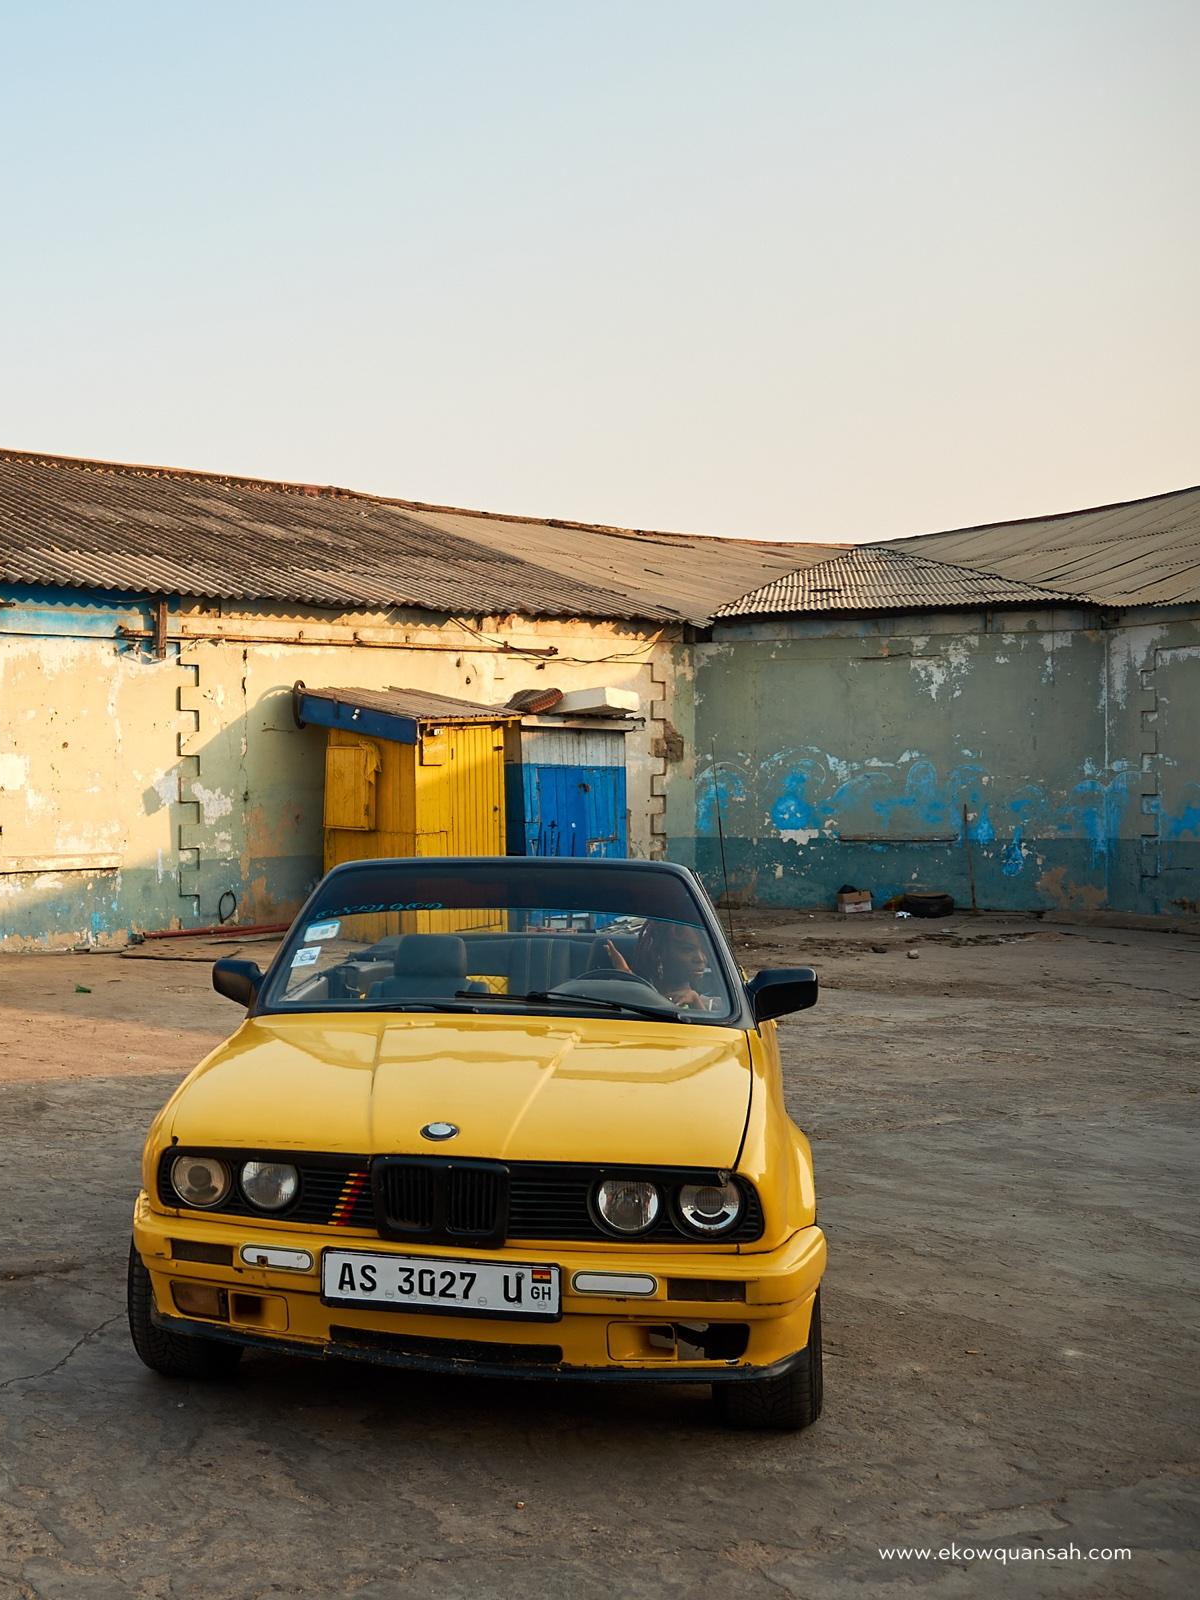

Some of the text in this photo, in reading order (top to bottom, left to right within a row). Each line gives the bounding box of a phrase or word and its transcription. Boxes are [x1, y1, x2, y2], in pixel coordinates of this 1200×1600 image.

[338, 1262, 523, 1304] AS 3027 U
[531, 1286, 552, 1301] GH
